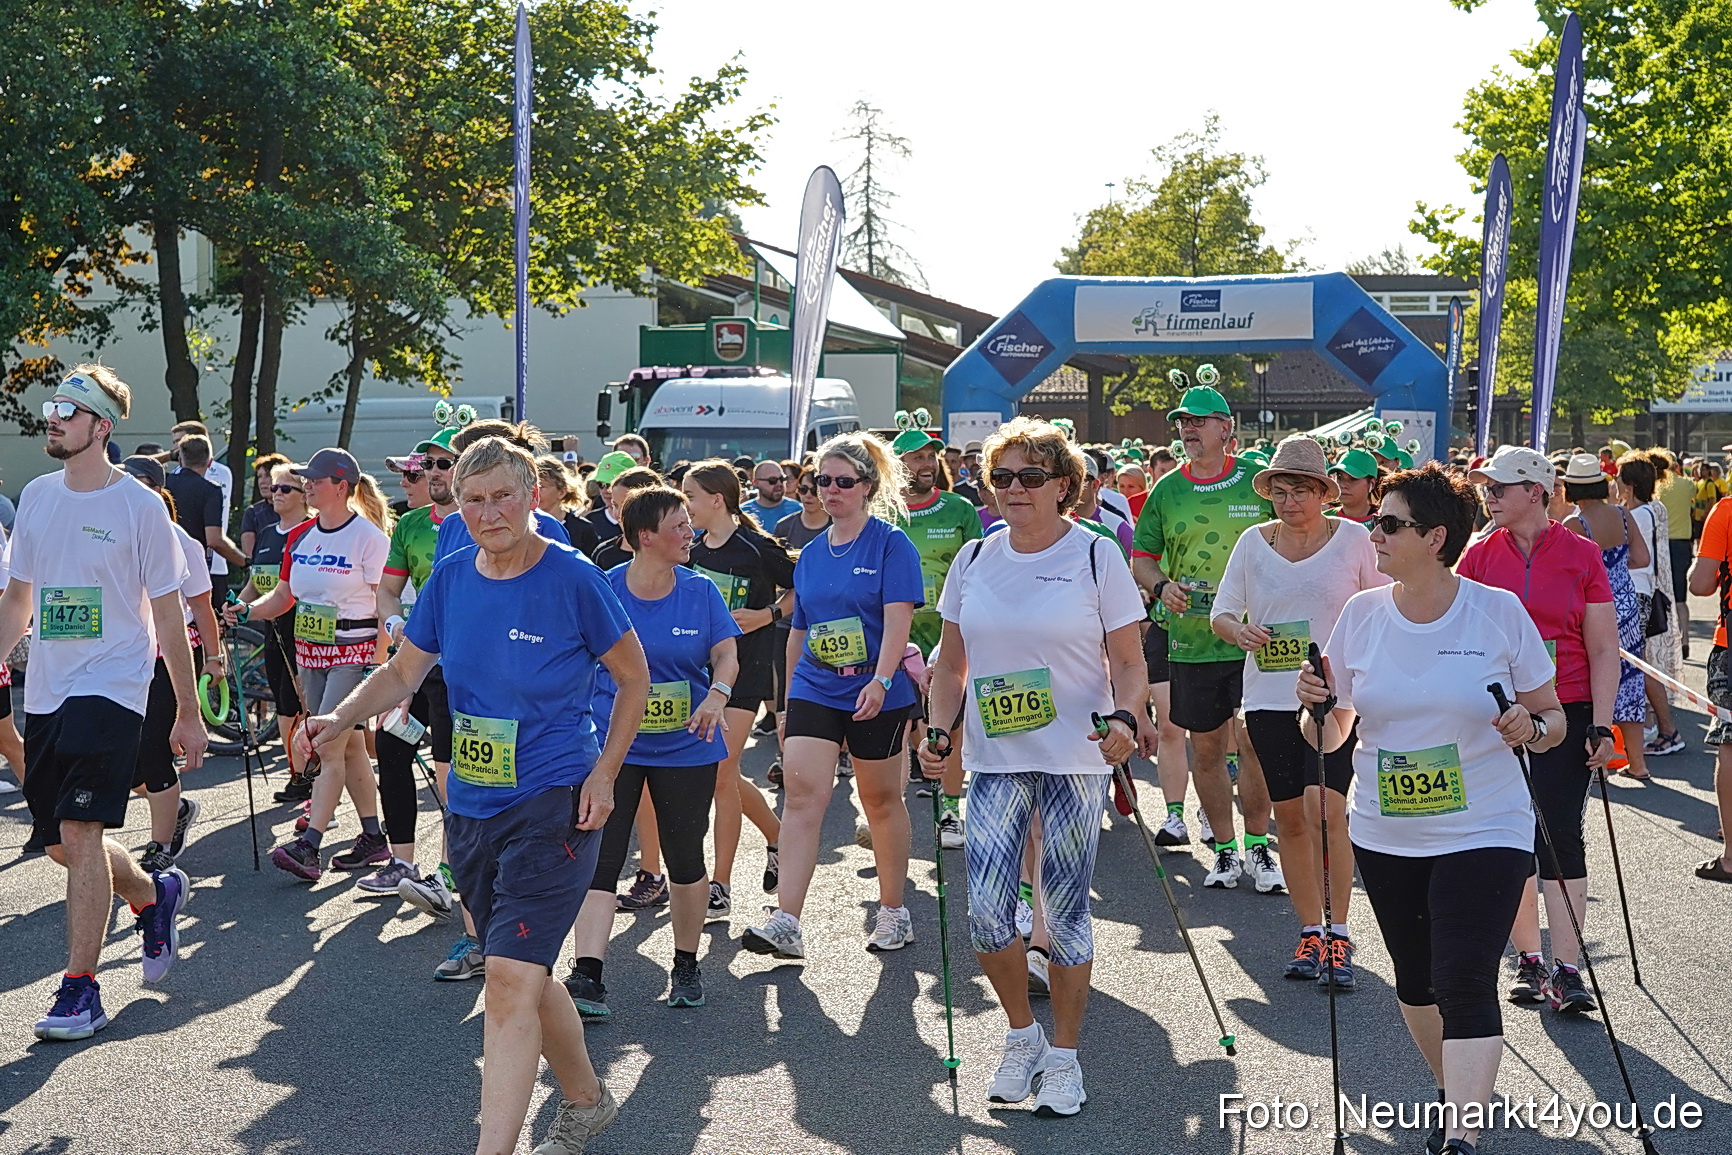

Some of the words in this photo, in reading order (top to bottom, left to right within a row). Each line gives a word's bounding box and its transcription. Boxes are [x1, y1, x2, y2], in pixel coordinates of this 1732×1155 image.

[808, 192, 834, 287] Fischer
[1187, 296, 1218, 305] Fischer
[1166, 312, 1255, 330] firmenlauf
[992, 338, 1044, 353] Fischer
[317, 566, 351, 576] energie
[256, 575, 272, 587] 408
[48, 605, 90, 623] 1473
[91, 607, 99, 632] 2022
[302, 615, 323, 631] 331
[50, 623, 64, 631] Stieg
[519, 631, 544, 644] Berger
[820, 635, 849, 654] 439
[855, 634, 864, 657] 2022
[311, 645, 342, 657] AVIA
[344, 641, 377, 656] AVIA
[835, 650, 854, 659] Karina
[1261, 638, 1301, 657] 1533
[988, 690, 1041, 717] 1976
[1041, 691, 1053, 719] 2022
[980, 701, 992, 730] WALK
[992, 718, 1013, 727] Braun
[1013, 712, 1043, 723] Irmgard
[459, 738, 494, 764] 459
[471, 763, 499, 775] Patricia
[502, 747, 511, 778] 2022
[1380, 775, 1390, 808] WALK
[1388, 769, 1449, 796] 1934
[1449, 771, 1462, 803] 2022
[1388, 796, 1418, 805] Schmidt
[1418, 793, 1453, 804] Johanna
